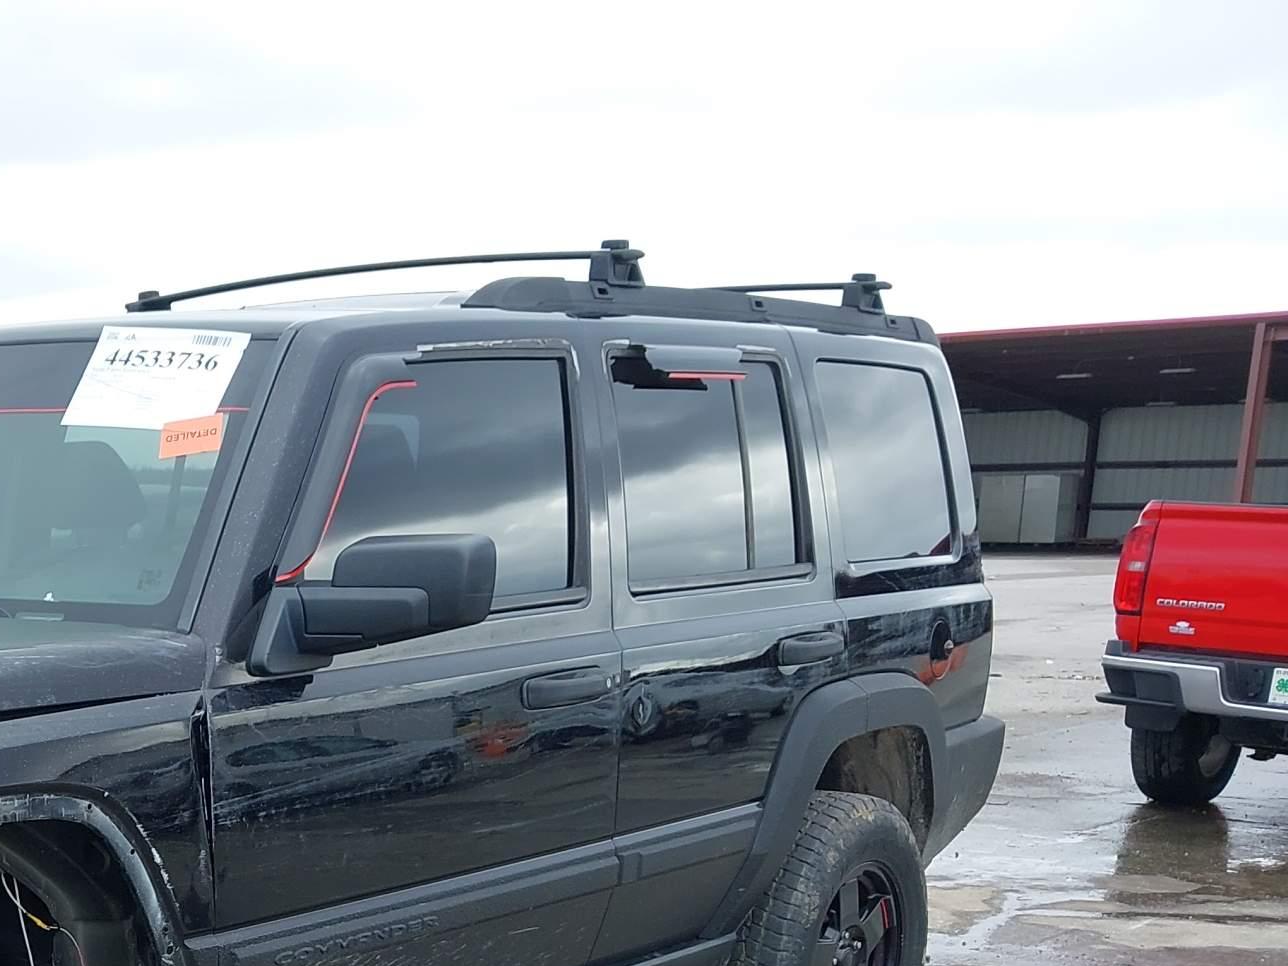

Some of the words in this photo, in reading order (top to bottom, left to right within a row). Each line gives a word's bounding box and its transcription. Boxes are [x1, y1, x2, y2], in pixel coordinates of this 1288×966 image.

[105, 348, 219, 371] 44533736
[165, 427, 217, 443] DETAILED
[1156, 598, 1225, 610] COLORADO
